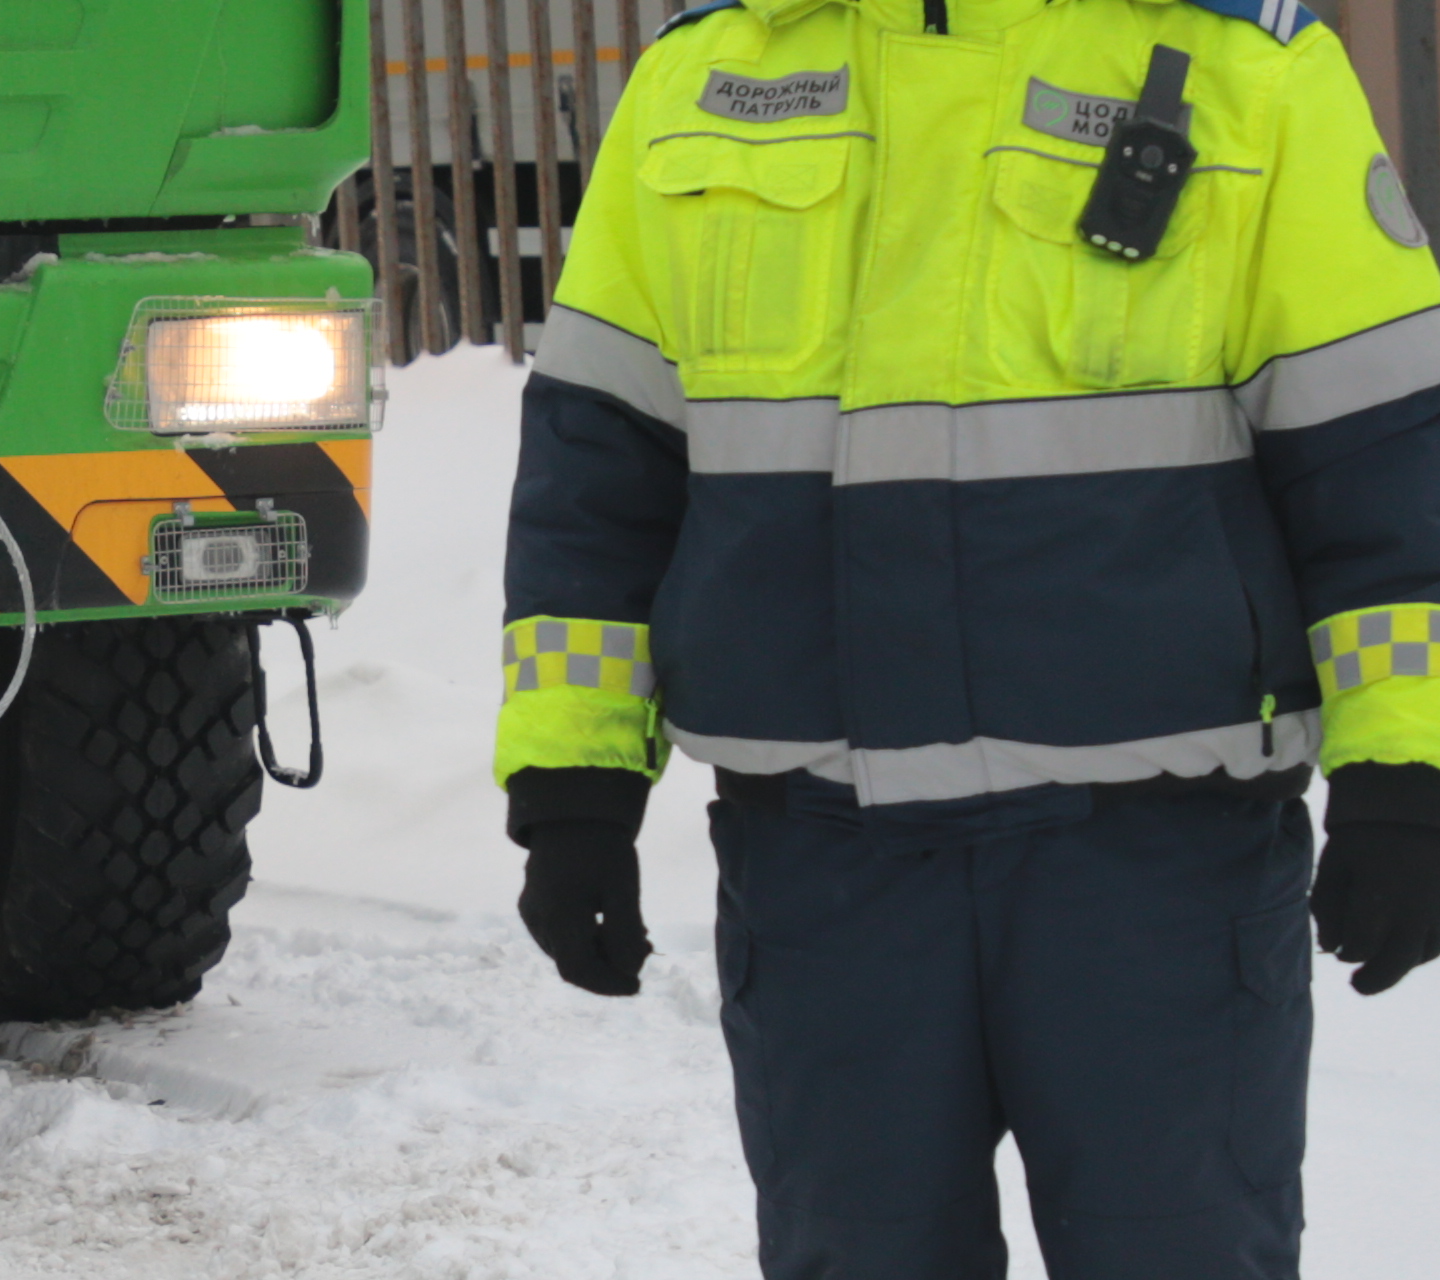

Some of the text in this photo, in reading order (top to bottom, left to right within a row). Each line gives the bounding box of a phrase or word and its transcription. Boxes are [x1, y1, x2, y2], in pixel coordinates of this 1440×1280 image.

[716, 75, 842, 101] ДОРОЖНЫЙ
[729, 95, 822, 116] ПАТРУЛЬ
[1076, 100, 1128, 123] ЦОД
